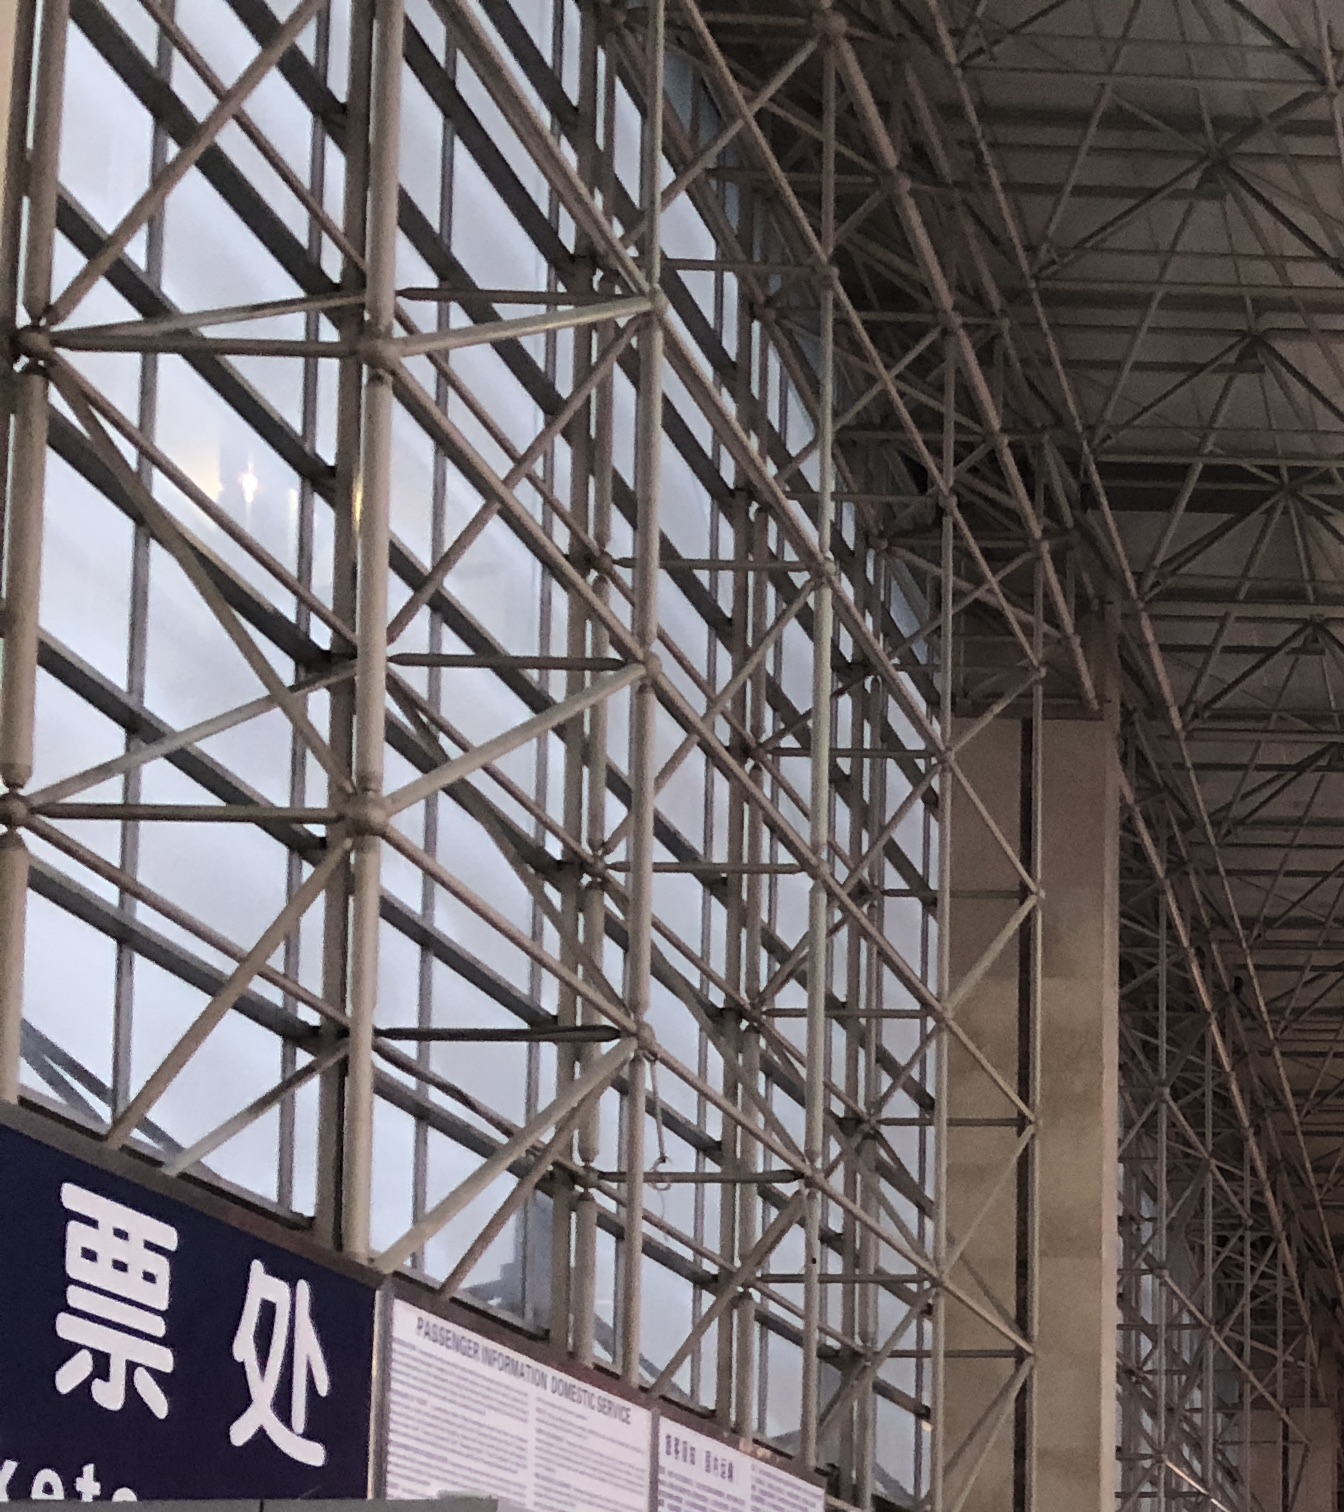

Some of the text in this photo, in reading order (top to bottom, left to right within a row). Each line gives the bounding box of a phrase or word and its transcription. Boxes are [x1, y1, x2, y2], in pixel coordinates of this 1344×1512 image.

[55, 1182, 329, 1468] 票处
[416, 1316, 632, 1425] PASSENGER INFORMATION DOMESTIC SERVICE
